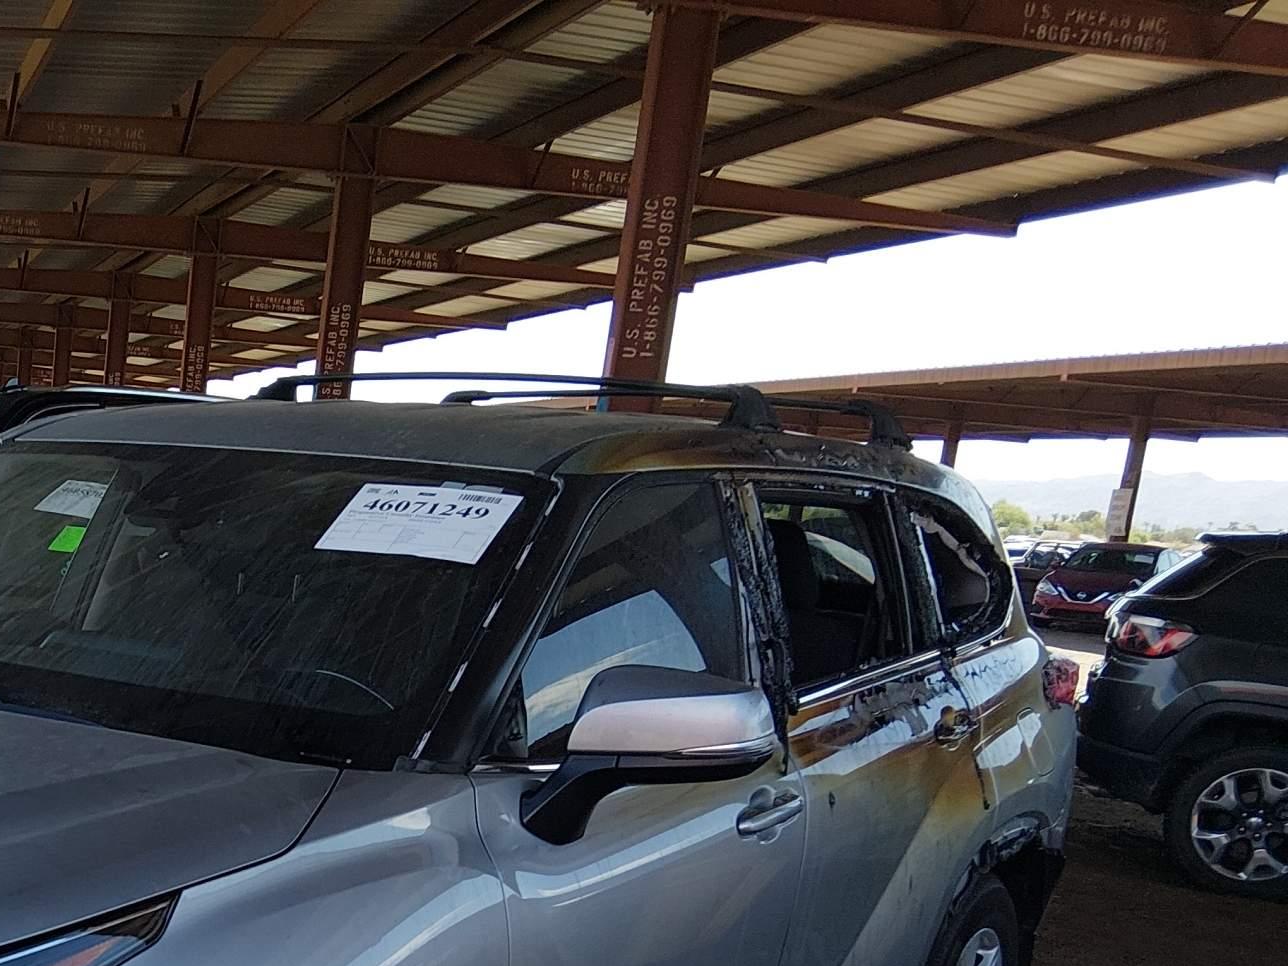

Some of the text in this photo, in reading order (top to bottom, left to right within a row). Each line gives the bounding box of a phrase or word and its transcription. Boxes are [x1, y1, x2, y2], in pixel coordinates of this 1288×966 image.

[1064, 7, 1131, 29] PREFAB
[598, 170, 632, 184] PREF
[622, 193, 661, 358] U.S. PREFAB INC.
[640, 196, 677, 357] 1-866-799-0969
[363, 499, 490, 519] 46071249
